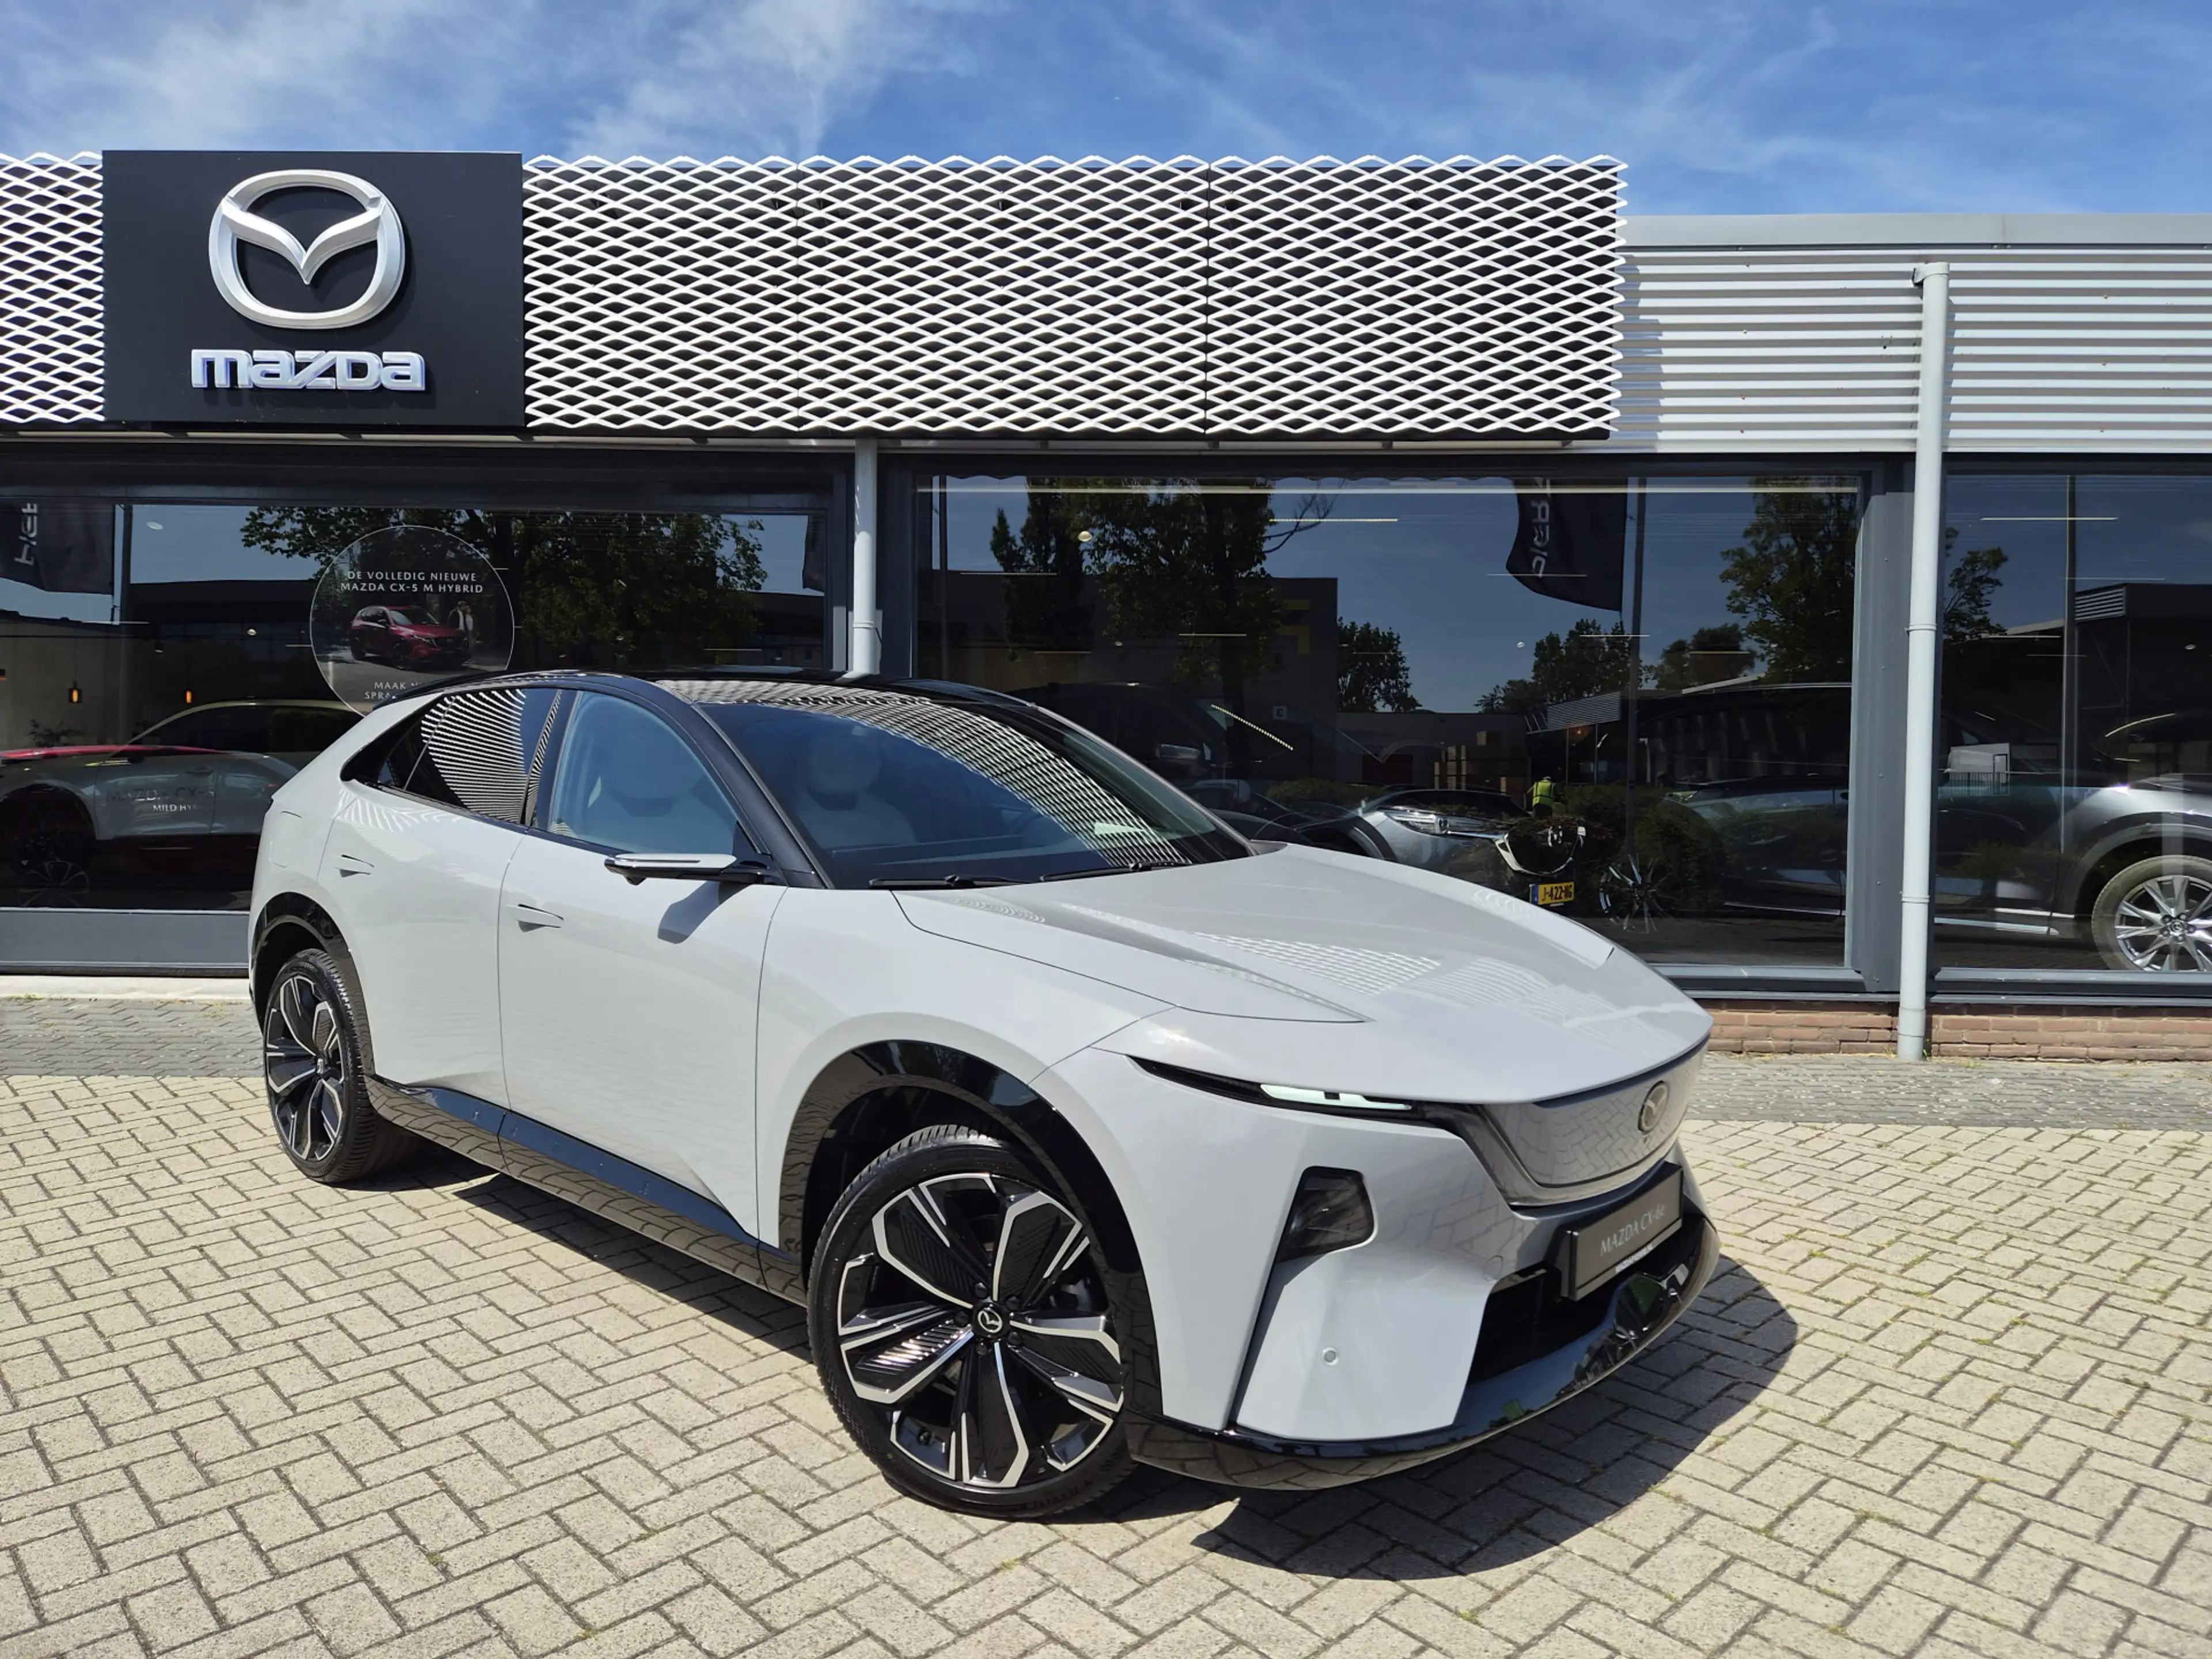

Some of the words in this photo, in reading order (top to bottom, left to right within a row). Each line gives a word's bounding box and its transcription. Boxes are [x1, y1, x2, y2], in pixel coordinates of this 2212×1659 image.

[191, 349, 425, 391] mazda
[340, 583, 385, 592] MAZDA
[389, 584, 418, 592] CX-5
[438, 584, 483, 593] HYBRID
[347, 571, 362, 580] DE
[366, 571, 426, 581] VOLLEDIG
[430, 572, 476, 582] NIEUWE
[1600, 1220, 1639, 1257] MAZDA
